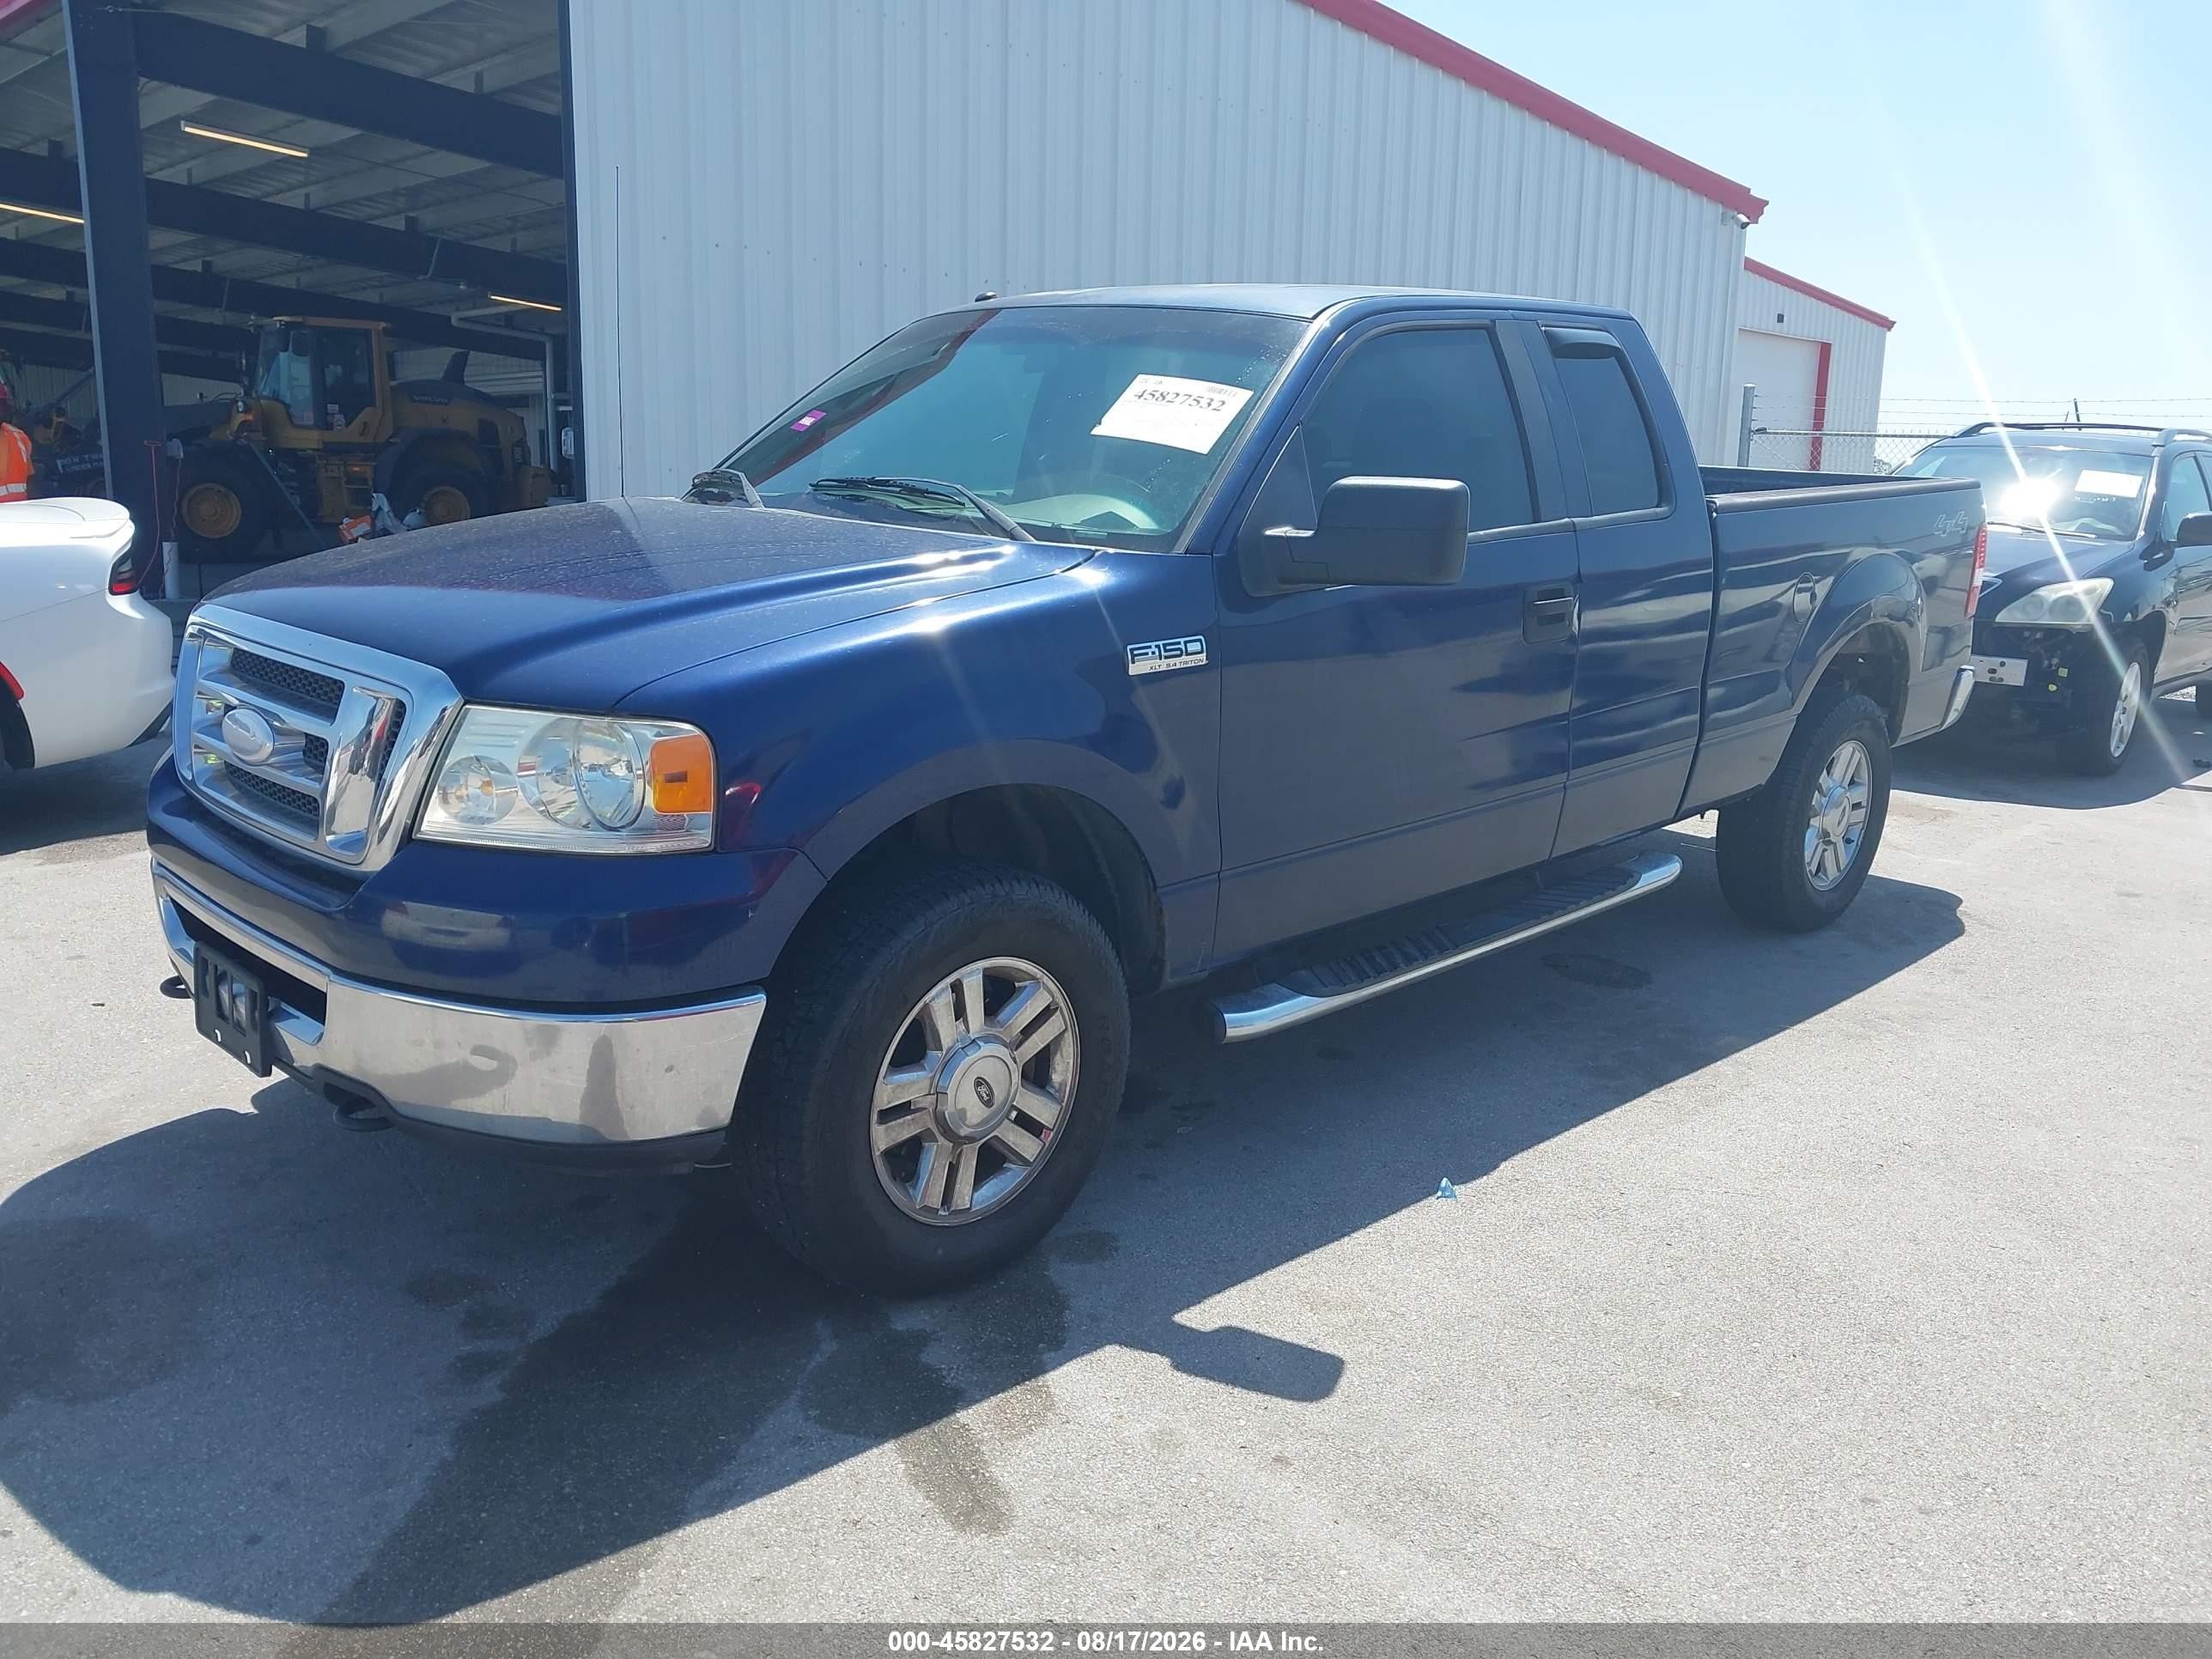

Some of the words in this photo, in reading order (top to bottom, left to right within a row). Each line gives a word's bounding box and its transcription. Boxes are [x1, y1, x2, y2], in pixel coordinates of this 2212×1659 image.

[1134, 388, 1226, 411] 45827532
[1129, 639, 1205, 665] F-150
[1179, 659, 1204, 667] TRITON
[977, 1085, 990, 1101] Ford
